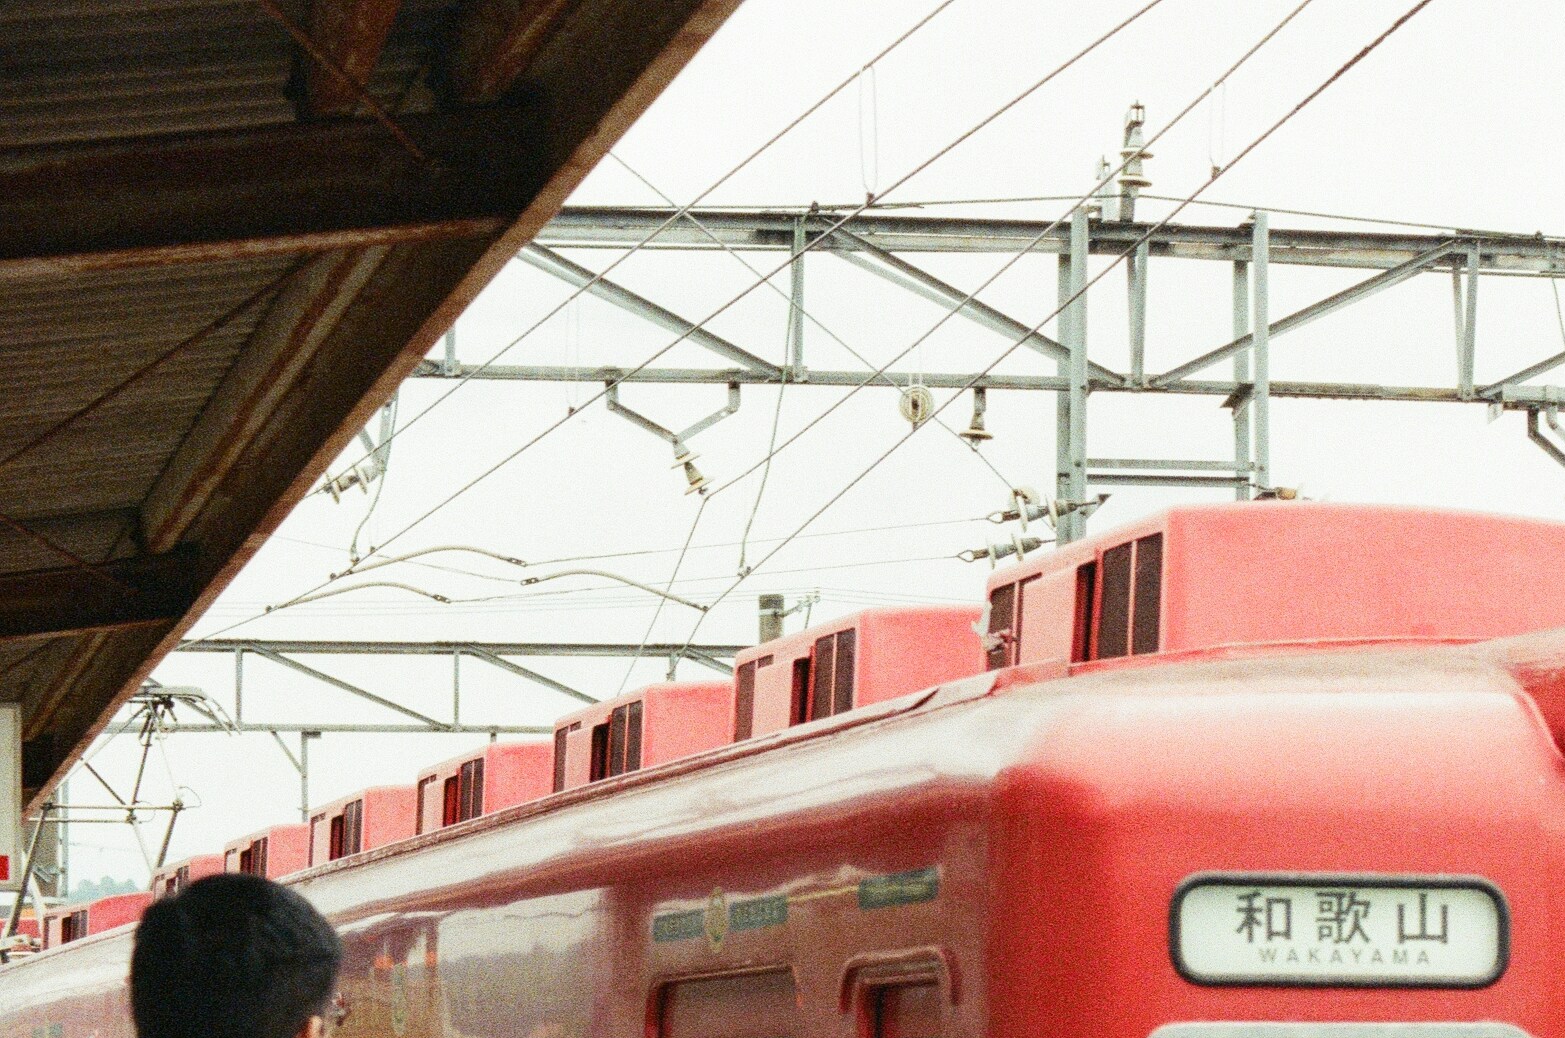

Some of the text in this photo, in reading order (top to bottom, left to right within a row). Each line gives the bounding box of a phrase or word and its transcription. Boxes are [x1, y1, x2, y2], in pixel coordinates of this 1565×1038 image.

[1236, 891, 1449, 944] 和歌山
[1259, 947, 1431, 965] WAKAYAMA
